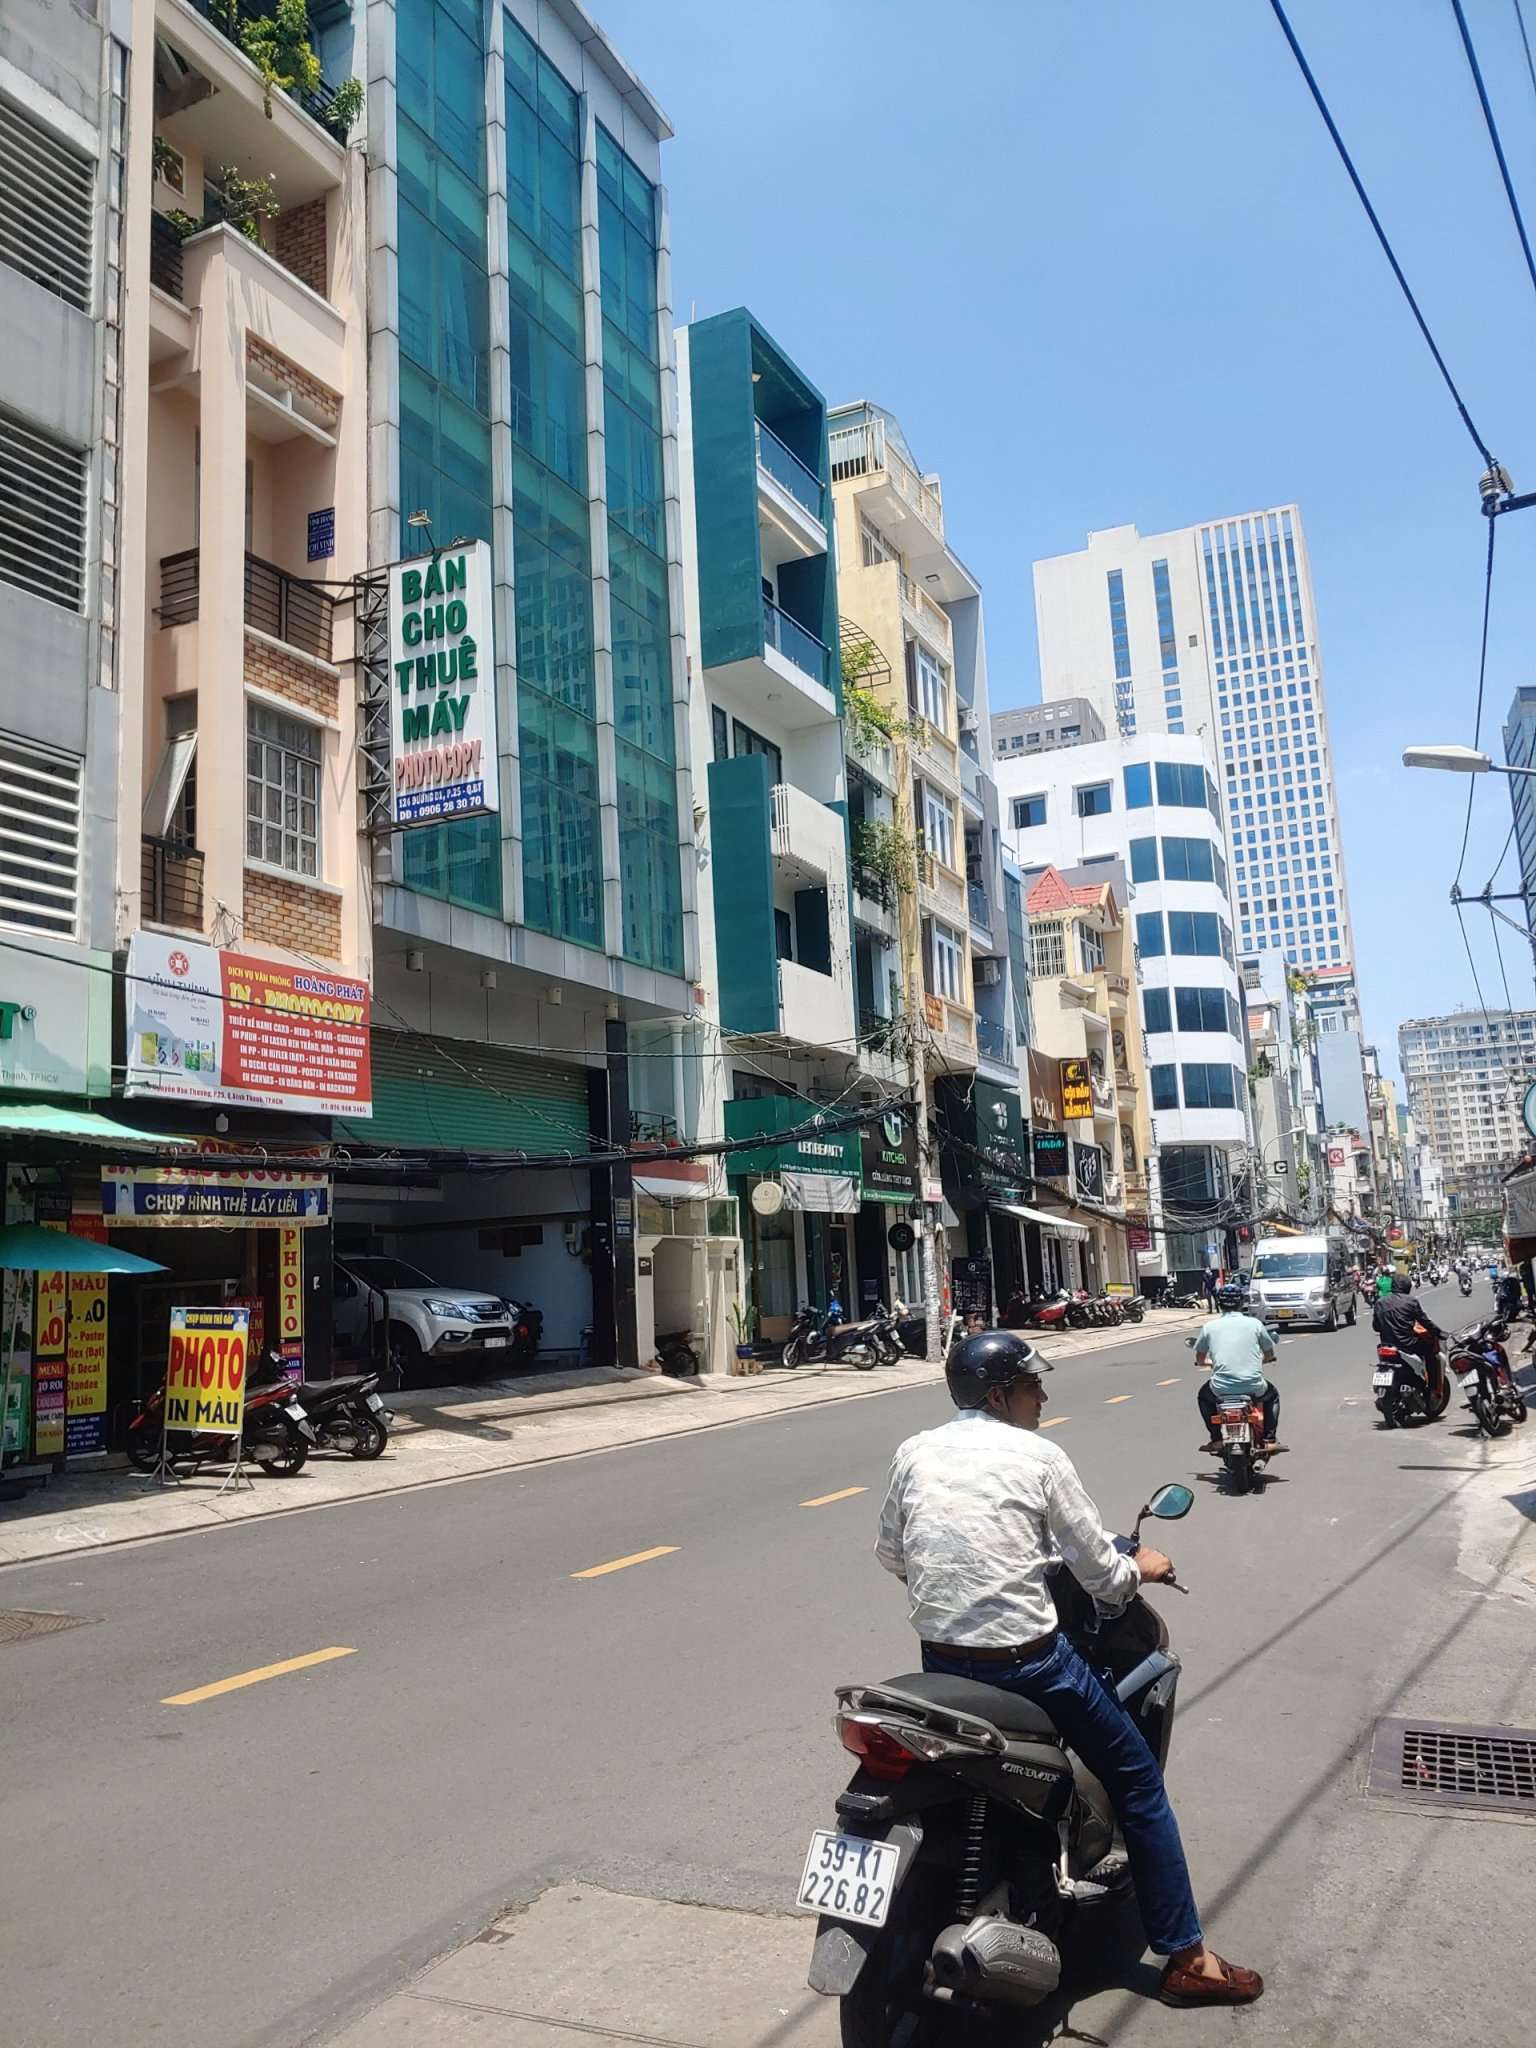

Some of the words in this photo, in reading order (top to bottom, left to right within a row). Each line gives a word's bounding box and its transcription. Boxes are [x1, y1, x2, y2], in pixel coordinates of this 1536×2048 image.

[402, 550, 466, 605] BÁN
[402, 600, 467, 646] CHO
[394, 635, 477, 695] THUÊ
[403, 691, 470, 742] MÁY
[395, 740, 481, 790] PHOTOCOPY
[419, 805, 441, 817] 0906
[443, 802, 454, 814] 28
[456, 799, 467, 811] 30
[469, 796, 481, 808] 70
[229, 982, 251, 1010] IN
[265, 989, 364, 1030] PHOTOCOPY
[294, 975, 334, 996] HOÀNG
[336, 983, 364, 1001] PHÁT
[882, 1151, 907, 1165] KITCHEN
[145, 1193, 185, 1215] CHỤP
[187, 1191, 221, 1212] HÌNH
[222, 1192, 247, 1213] THẺ
[252, 1190, 276, 1213] LẤY
[277, 1191, 298, 1213] LIỀN
[72, 1276, 105, 1291] MÀU
[283, 1230, 297, 1332] PHOTO
[169, 1336, 244, 1391] PHOTO
[168, 1398, 189, 1422] IN
[195, 1395, 238, 1424] MÀU
[820, 1838, 882, 1882] 59-K1
[804, 1871, 886, 1921] 226.82
